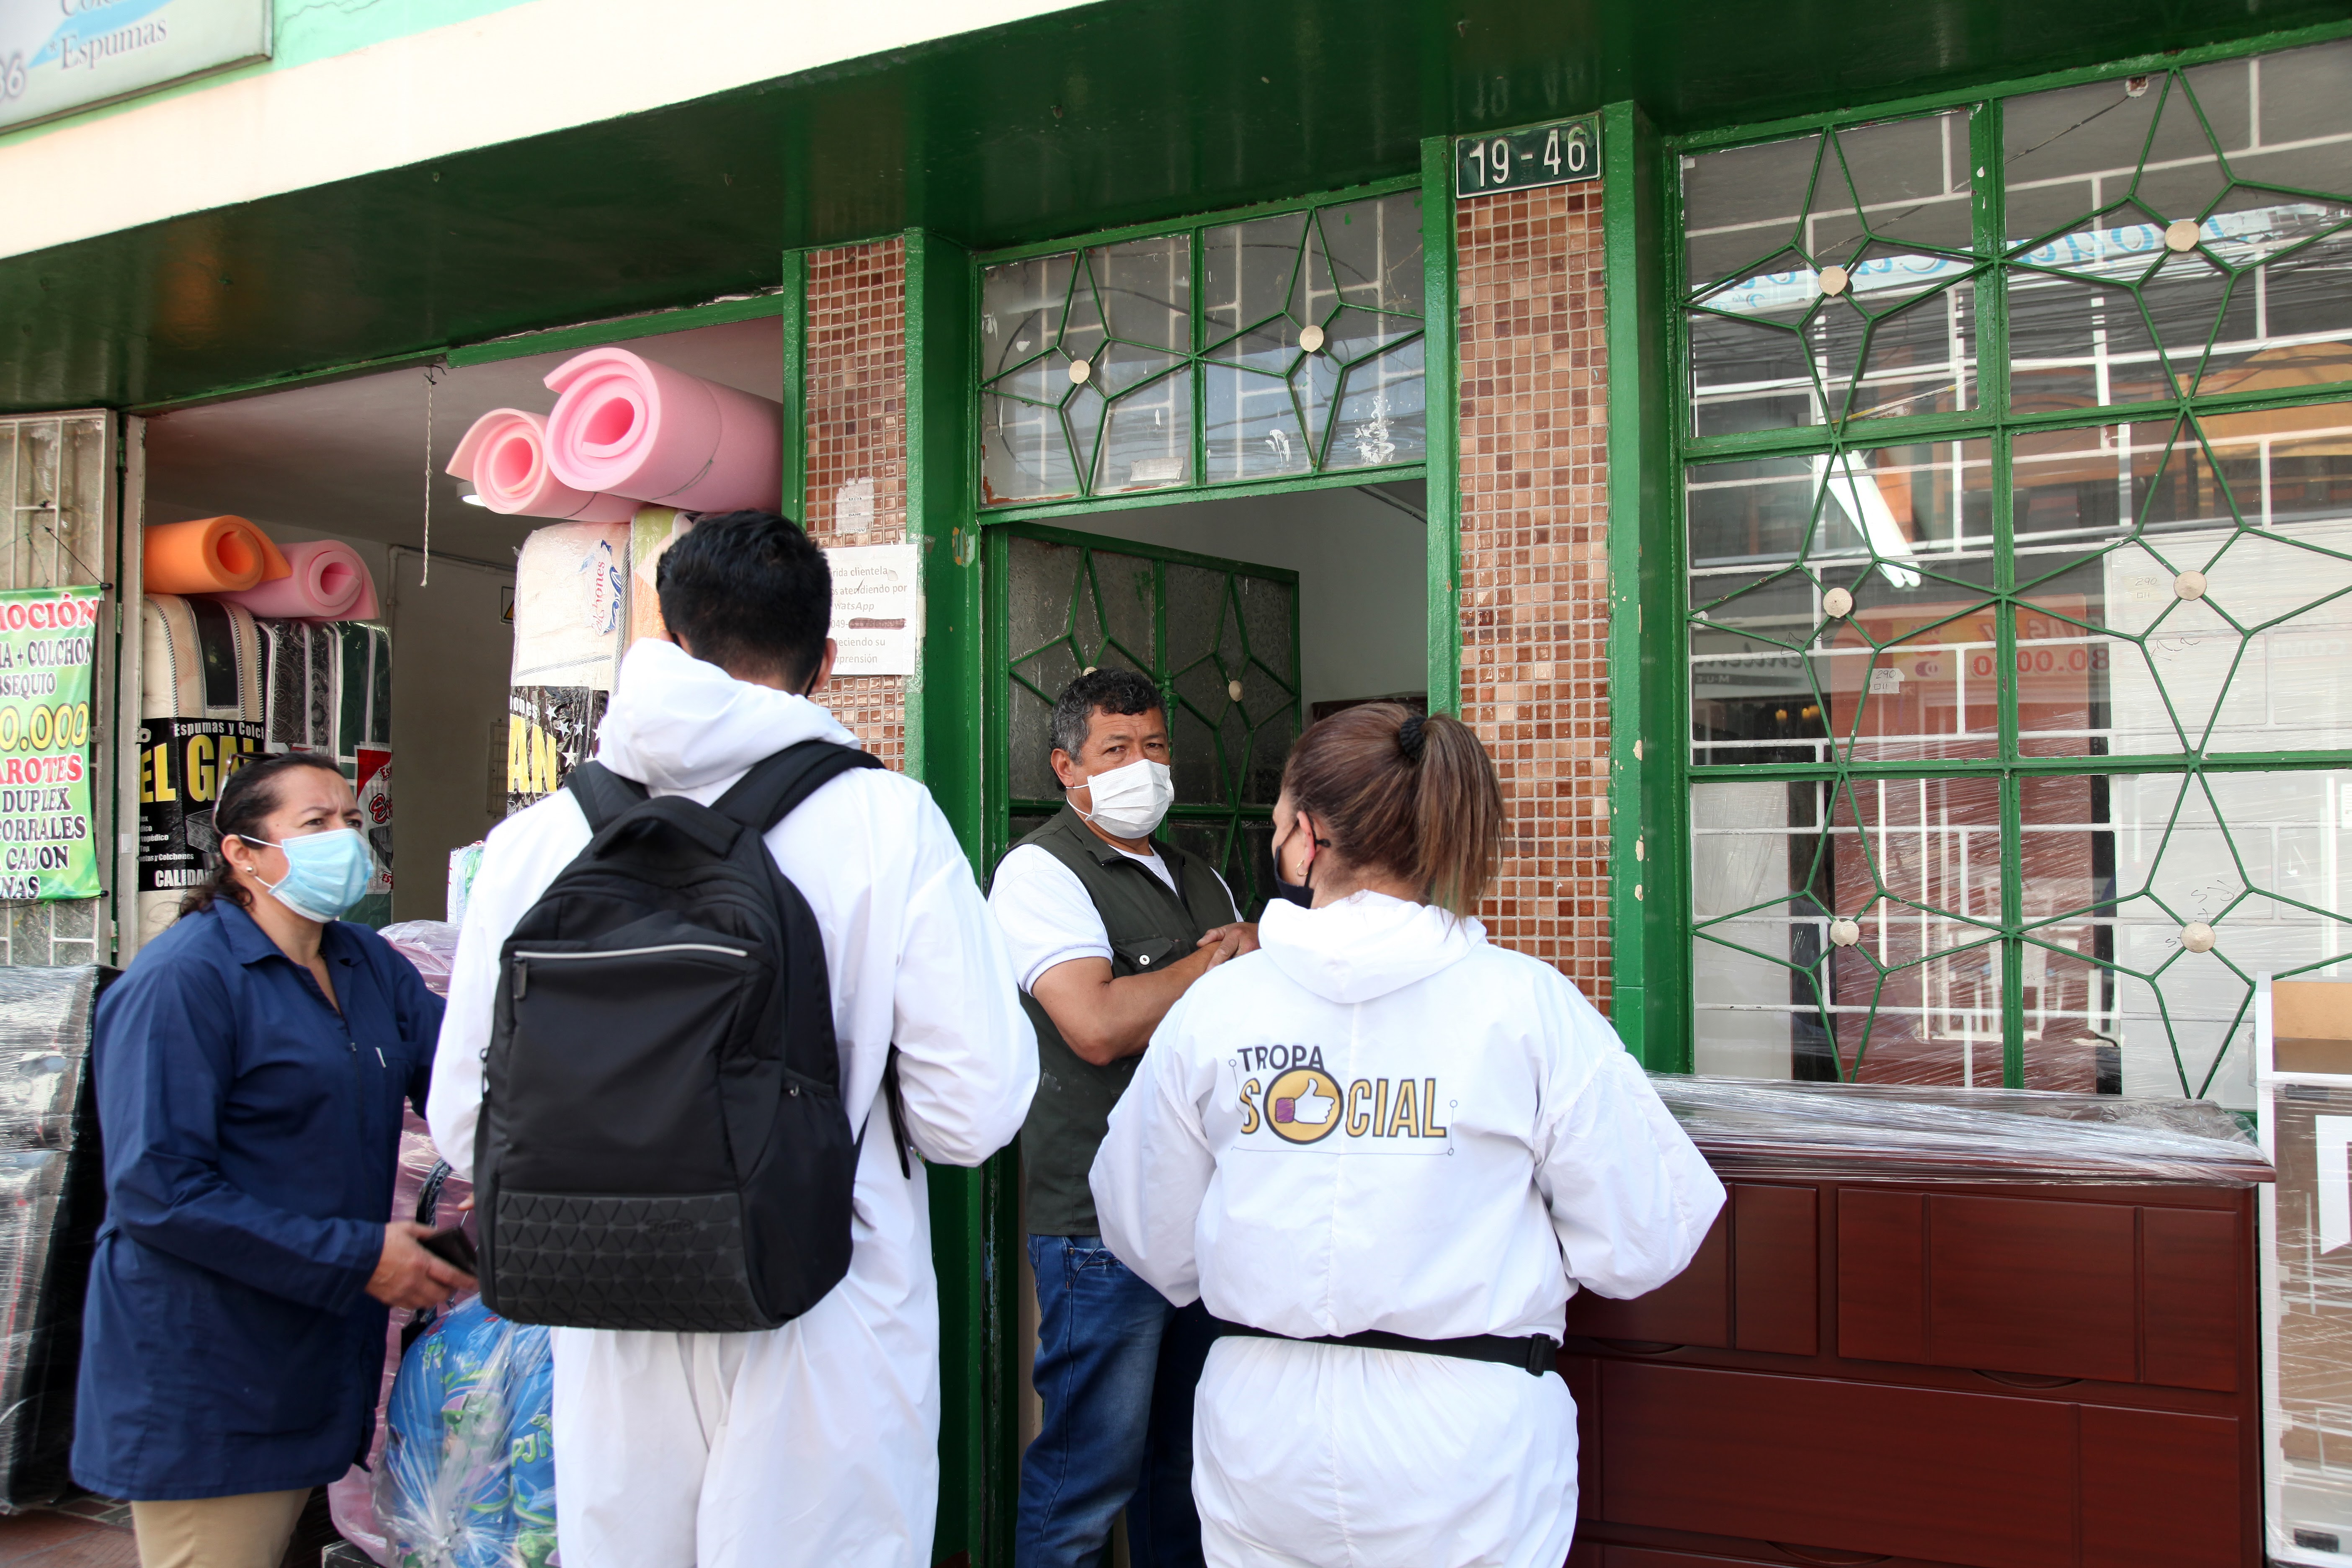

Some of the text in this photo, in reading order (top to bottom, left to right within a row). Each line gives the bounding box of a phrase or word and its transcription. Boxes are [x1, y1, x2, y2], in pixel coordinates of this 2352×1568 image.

[62, 20, 168, 70] Espumas
[850, 566, 887, 576] clientela
[840, 584, 890, 595] atendiendo
[892, 585, 908, 595] por
[836, 637, 873, 647] eciendo
[1876, 670, 1896, 679] 290
[174, 722, 224, 737] Espumas
[229, 723, 234, 735] y
[140, 743, 176, 803] EL
[3, 787, 72, 813] DUPLEX
[0, 815, 87, 842] ORRALES
[6, 845, 70, 871] CAJON
[159, 852, 194, 861] Colchones
[1237, 1044, 1325, 1073] TROPA
